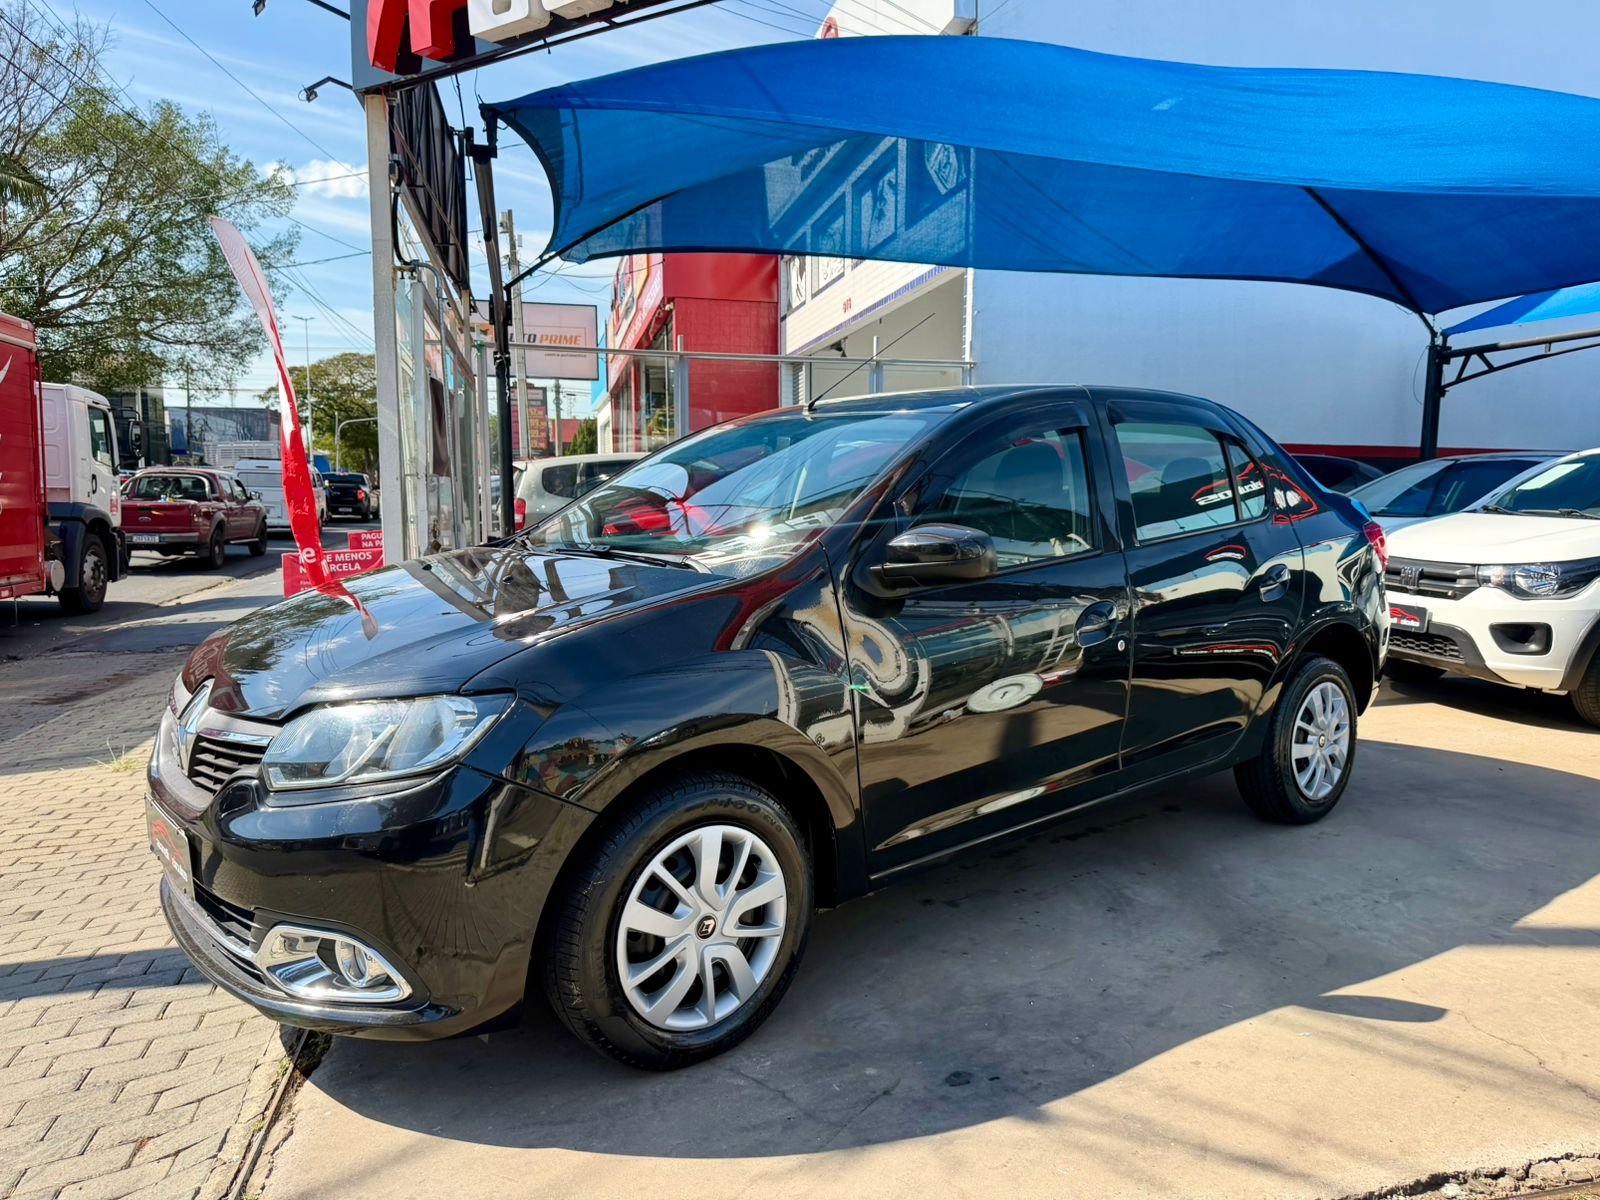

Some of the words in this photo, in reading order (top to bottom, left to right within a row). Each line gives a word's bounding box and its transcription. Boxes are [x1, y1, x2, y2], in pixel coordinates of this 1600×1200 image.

[540, 334, 582, 345] PRIME
[361, 532, 383, 541] PAGU
[335, 551, 372, 561] MENOS
[330, 562, 361, 572] RCELA
